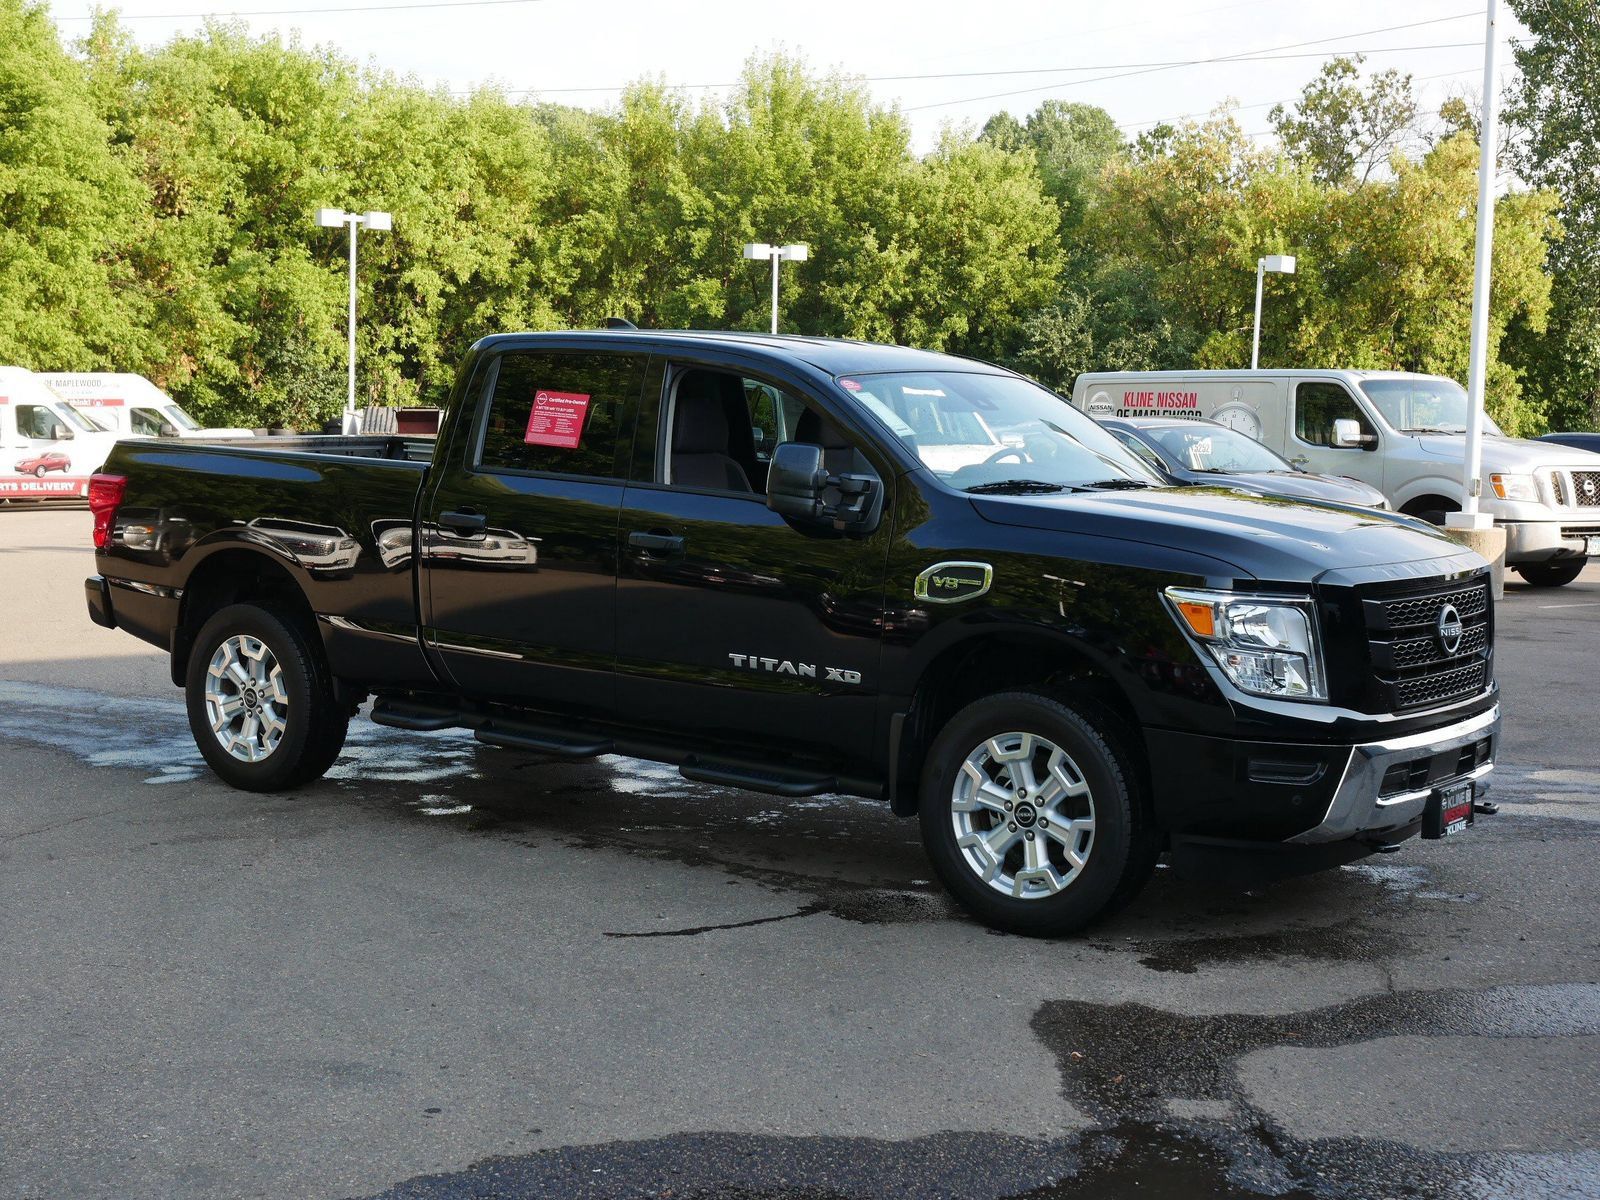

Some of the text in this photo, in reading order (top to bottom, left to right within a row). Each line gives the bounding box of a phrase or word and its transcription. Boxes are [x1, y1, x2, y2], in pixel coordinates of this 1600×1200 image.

[55, 379, 102, 387] MAPLEWOOD
[1123, 392, 1198, 408] KLINE NISSAN
[21, 482, 75, 491] DELIVERY
[1440, 627, 1461, 637] NISS
[728, 653, 861, 684] TITAN XD
